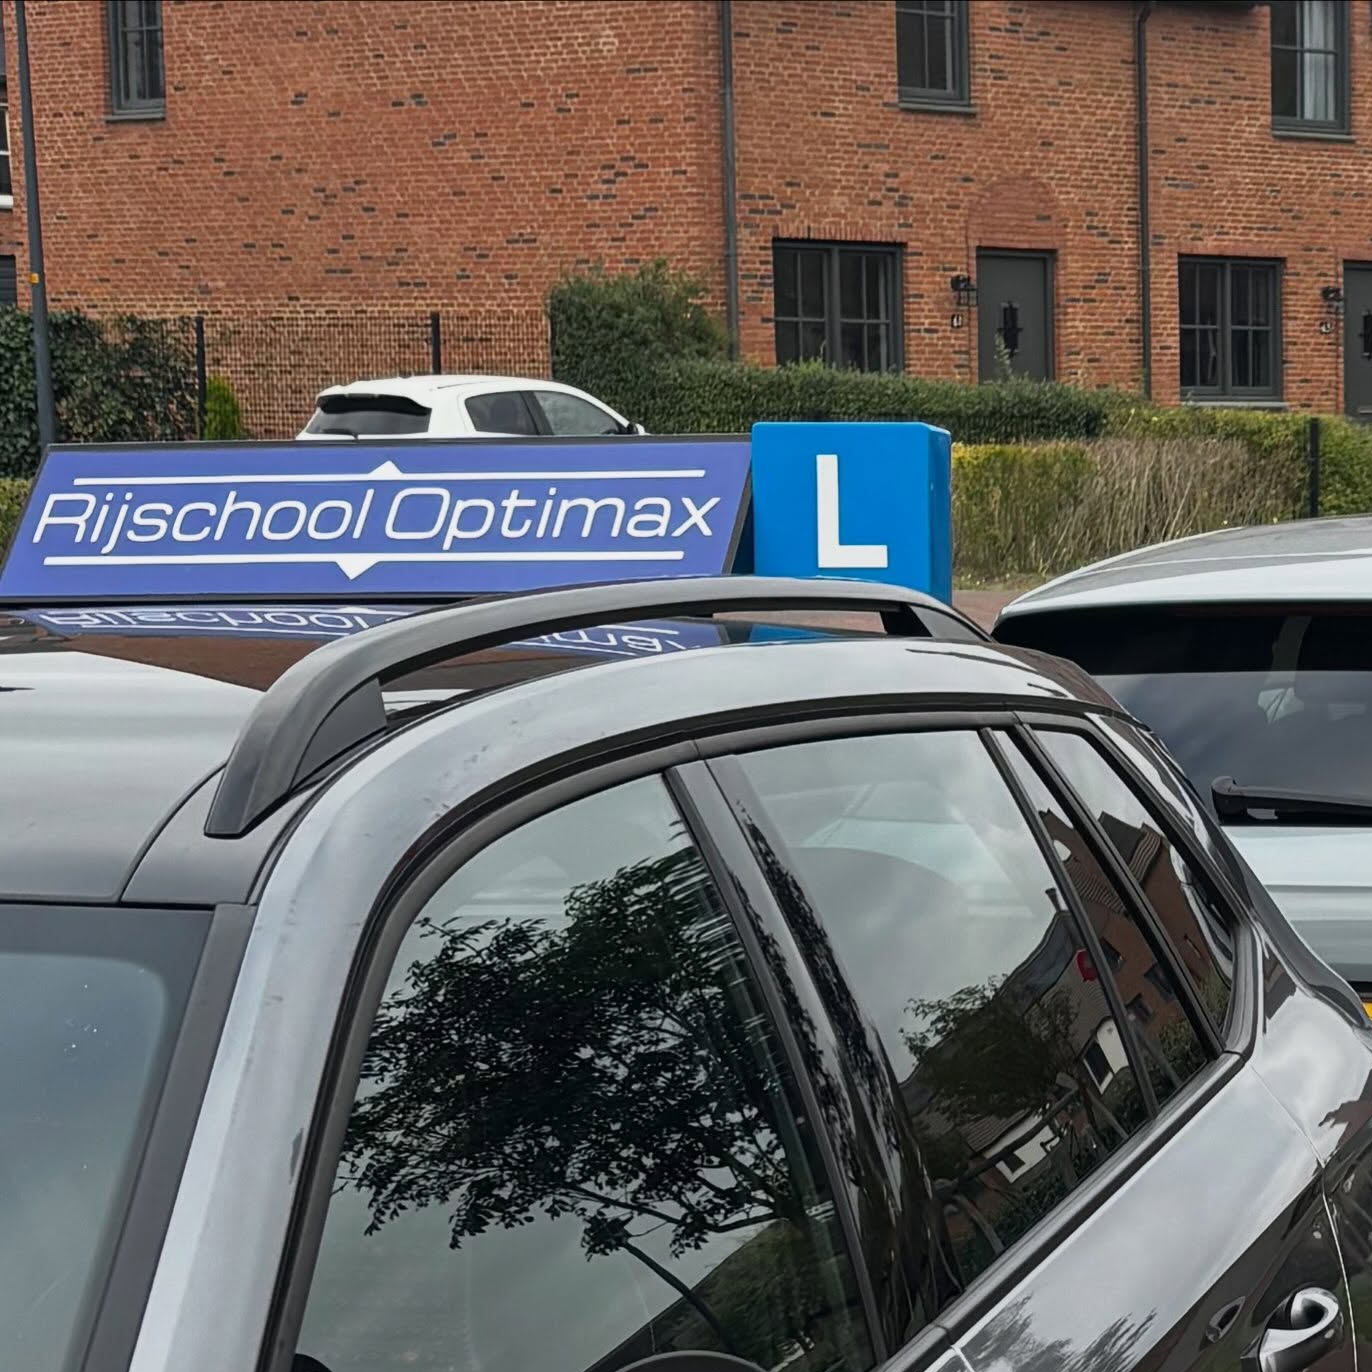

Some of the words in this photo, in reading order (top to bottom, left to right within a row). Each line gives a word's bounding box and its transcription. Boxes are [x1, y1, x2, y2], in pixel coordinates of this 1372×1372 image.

[33, 487, 375, 554] Rijschool
[385, 487, 720, 550] Optimax
[816, 454, 888, 569] L
